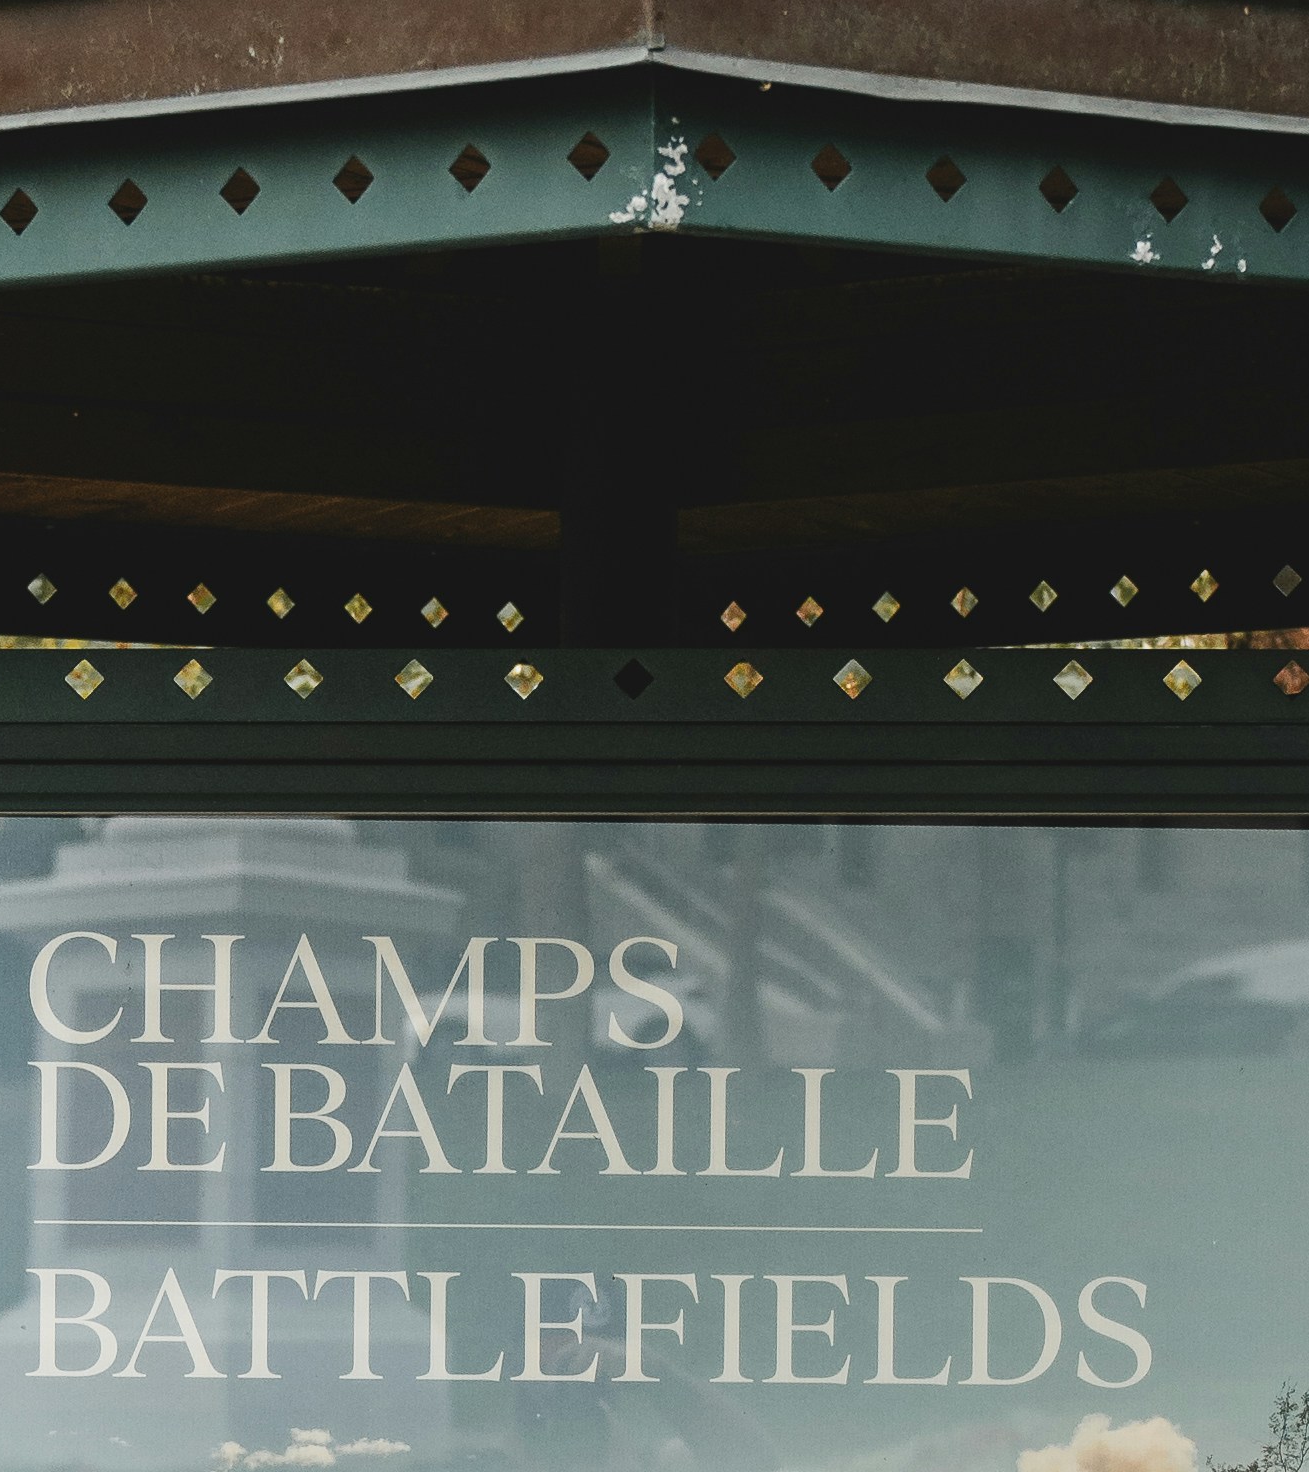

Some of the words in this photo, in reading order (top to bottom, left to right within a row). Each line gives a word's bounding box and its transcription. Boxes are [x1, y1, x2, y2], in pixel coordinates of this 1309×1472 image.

[29, 931, 684, 1049] CHAMPS
[26, 1061, 227, 1173] DE
[260, 1062, 974, 1179] BATAILLE
[25, 1266, 1152, 1389] BATTLEFIELDS
